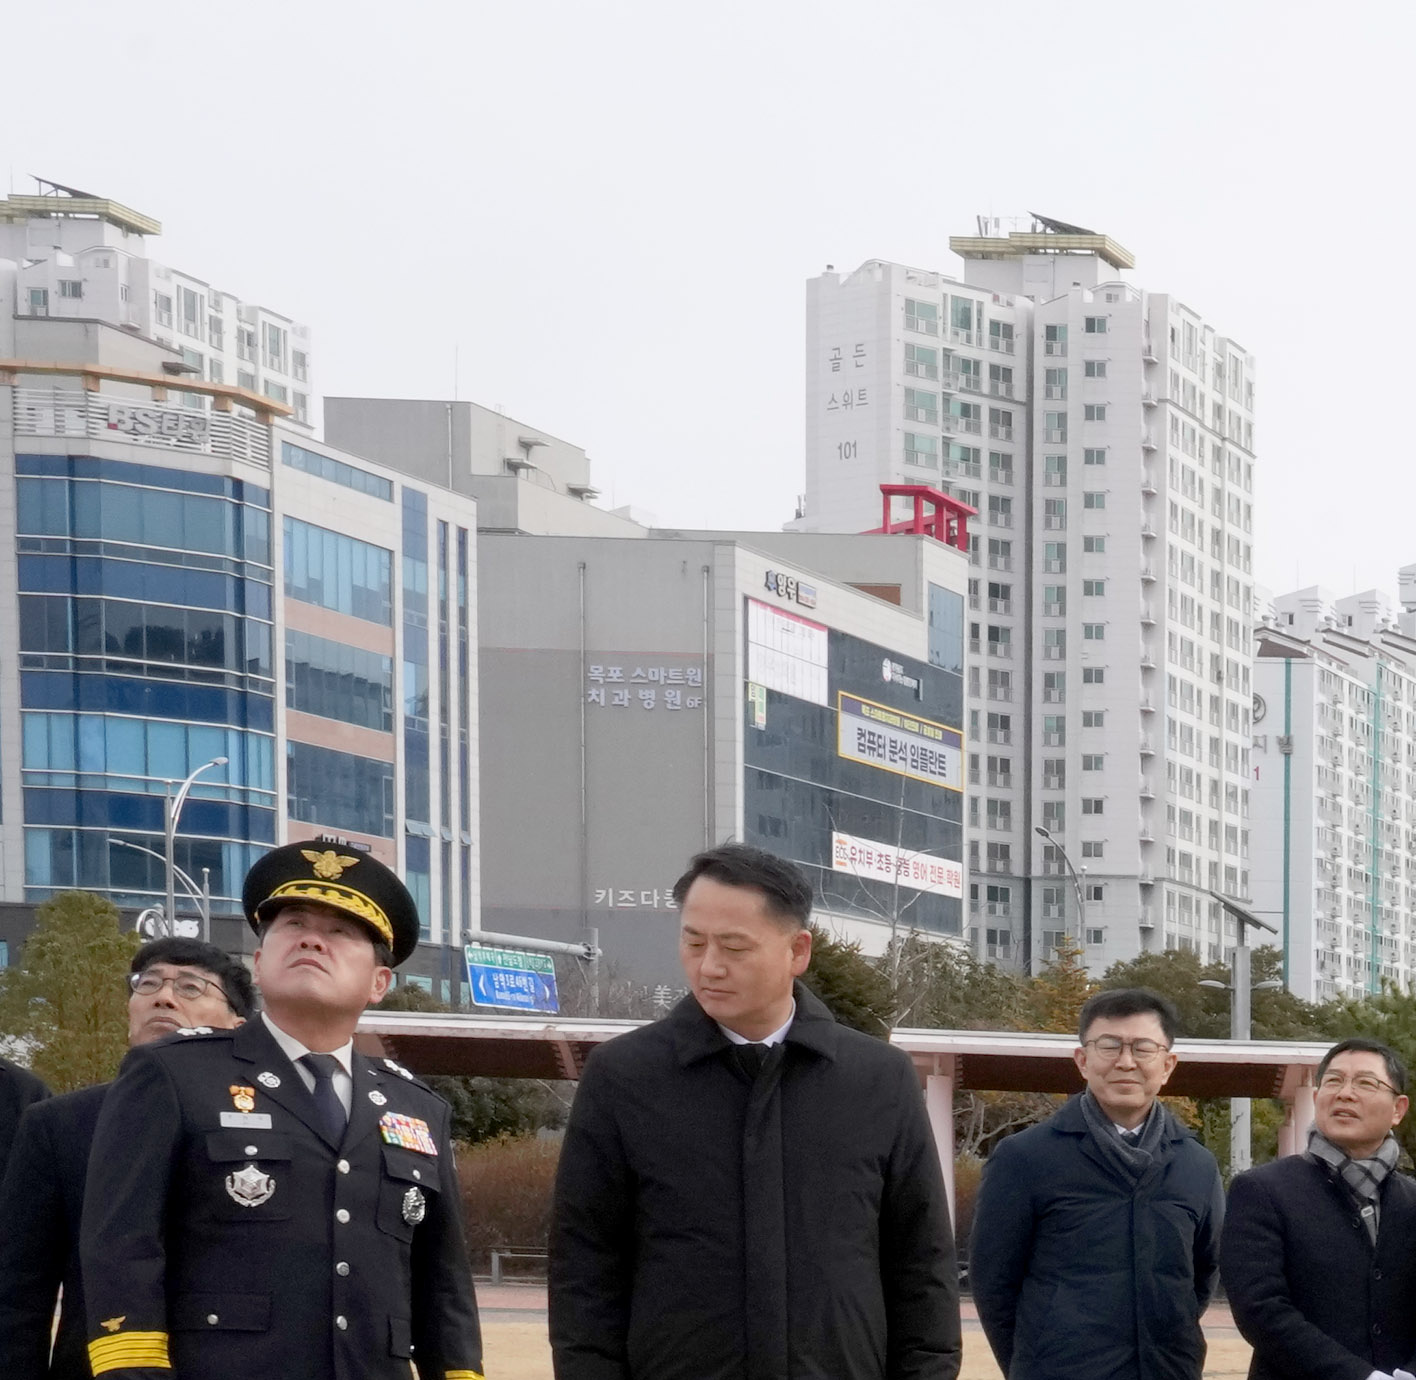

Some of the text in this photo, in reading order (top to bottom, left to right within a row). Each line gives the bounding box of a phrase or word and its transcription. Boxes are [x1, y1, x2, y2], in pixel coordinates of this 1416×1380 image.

[827, 388, 869, 411] 스위트
[838, 440, 857, 460] 101
[587, 665, 702, 687] 목포 스마트원
[587, 688, 702, 710] 치과병원 6F
[857, 727, 886, 761] 컴퓨터
[889, 736, 908, 764] 분석
[909, 744, 946, 778] 임플란트
